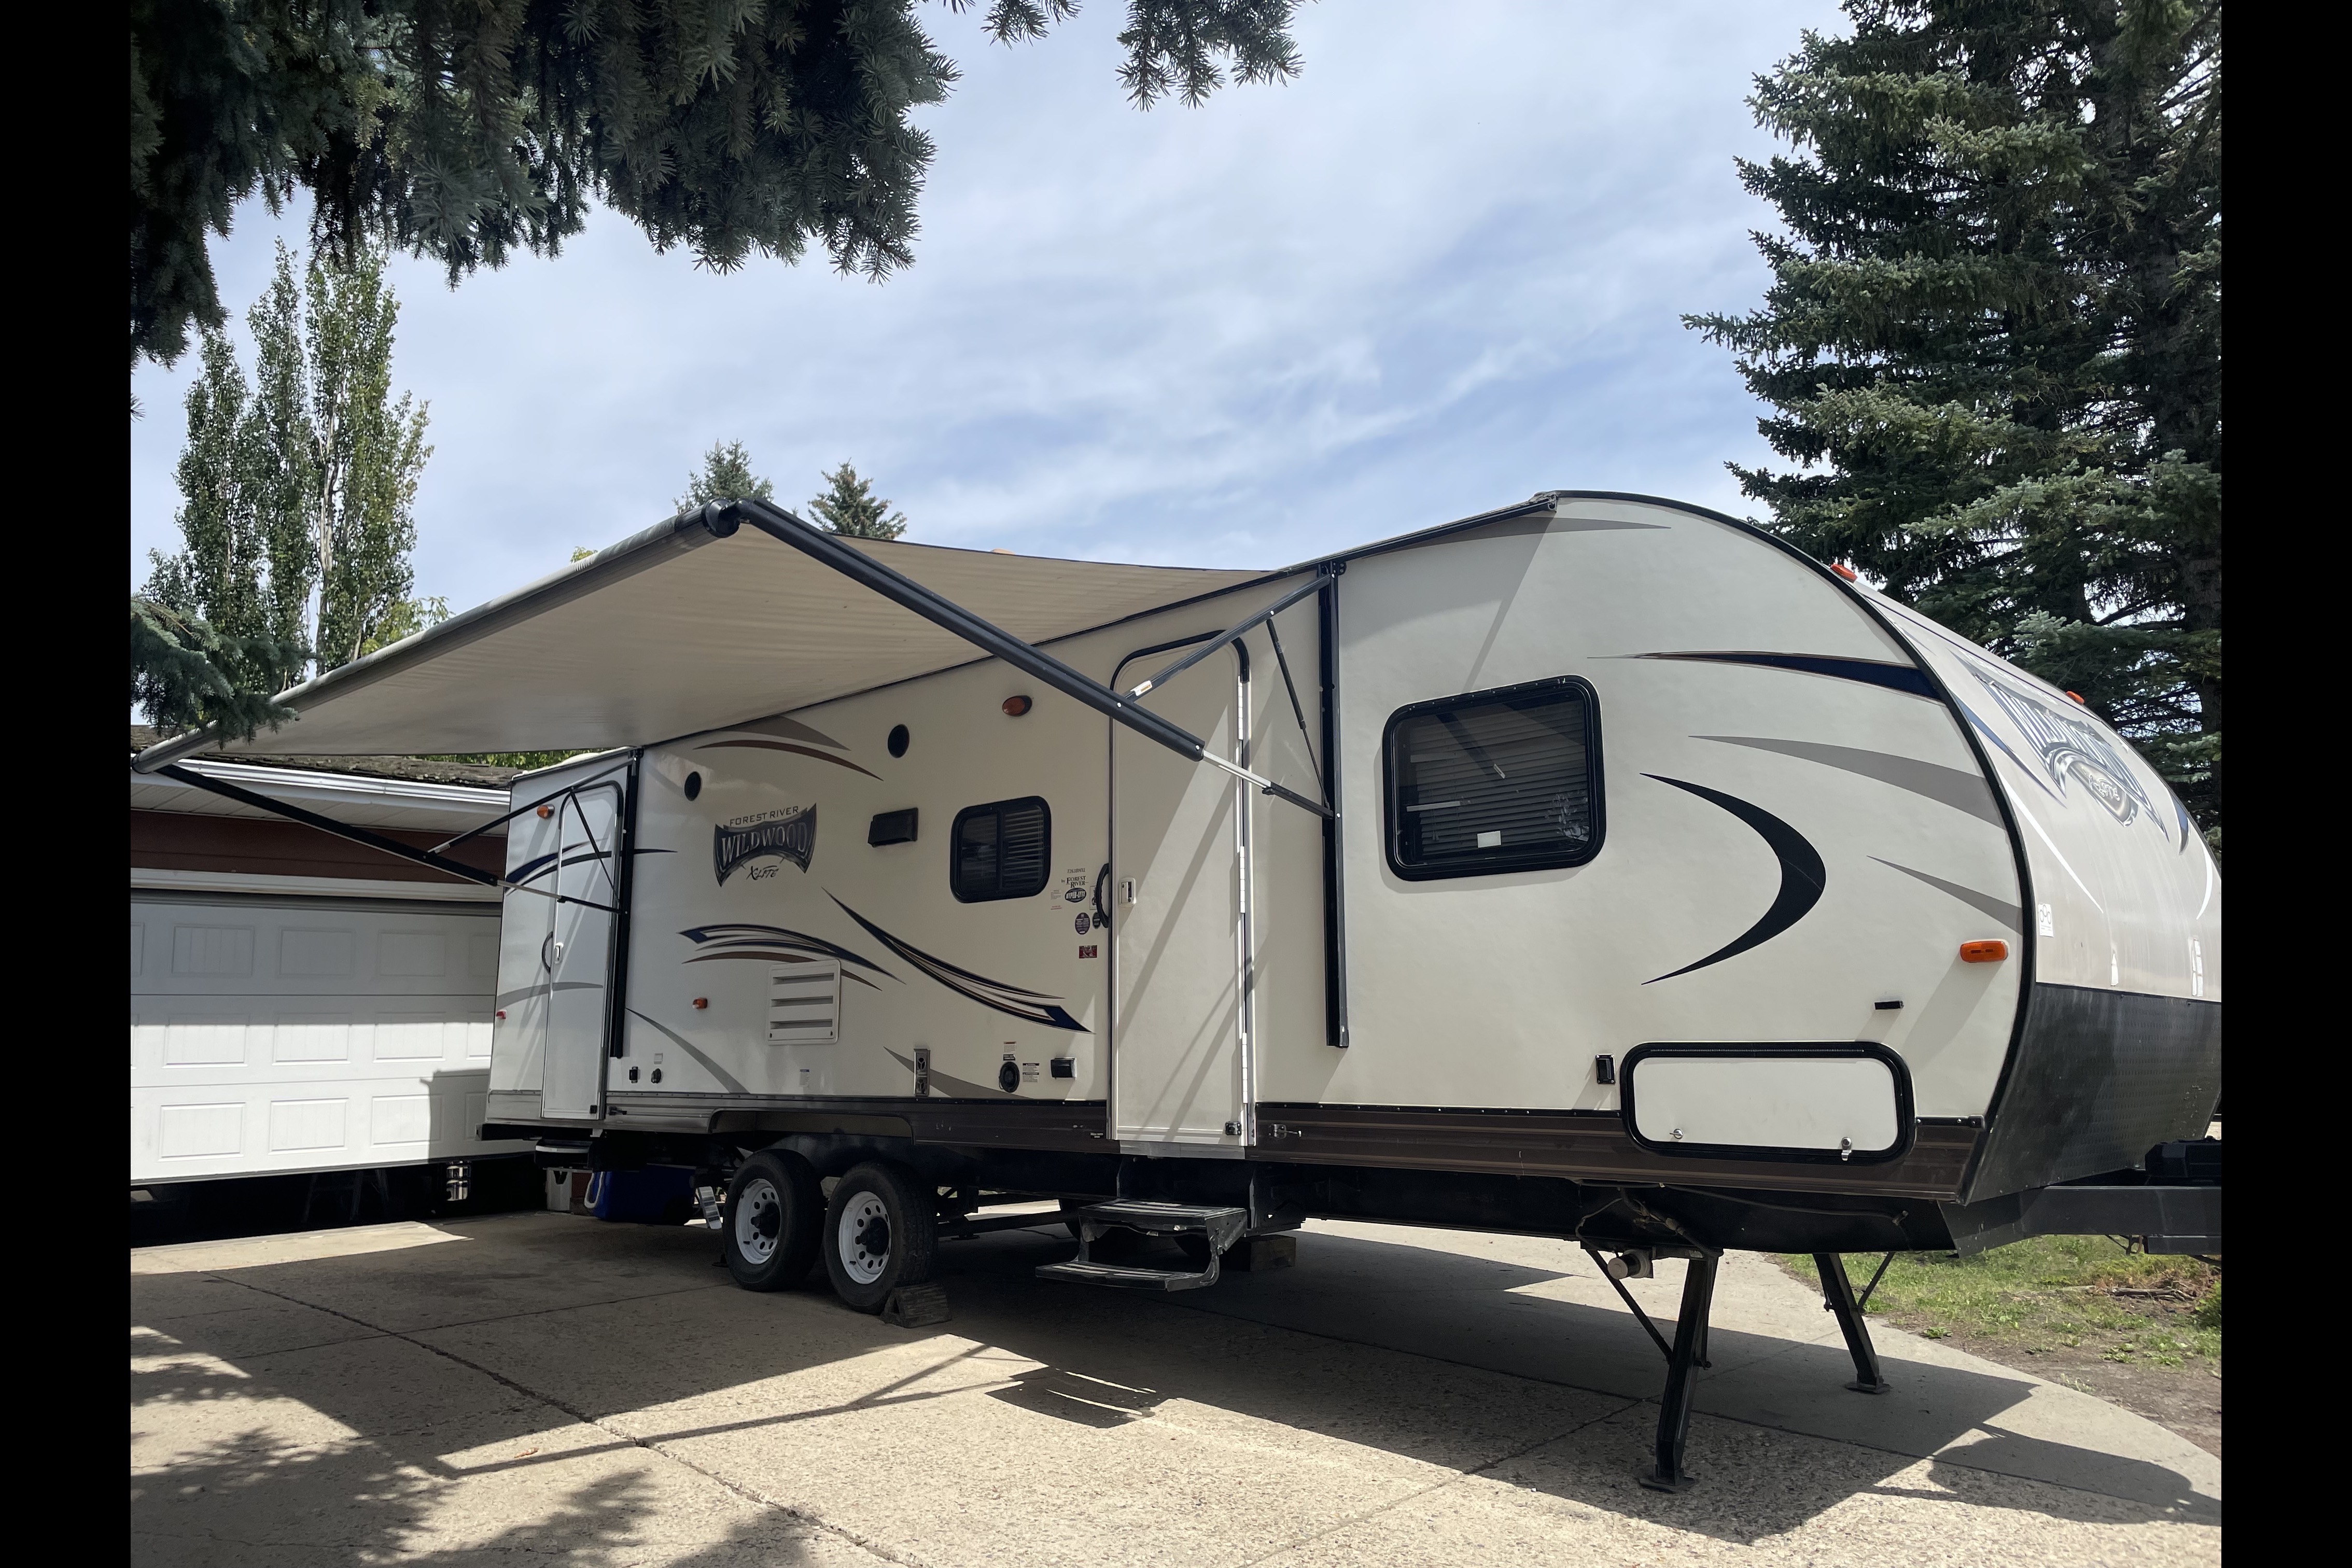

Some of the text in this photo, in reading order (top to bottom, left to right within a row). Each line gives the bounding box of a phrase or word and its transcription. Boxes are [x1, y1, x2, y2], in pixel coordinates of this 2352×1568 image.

[1989, 683, 2143, 797] WILDWOOD
[730, 806, 799, 827] FOREST RIVER
[721, 822, 807, 867] WILDWOOD
[746, 865, 779, 880] X-LITE
[1067, 876, 1086, 884] FOREST
